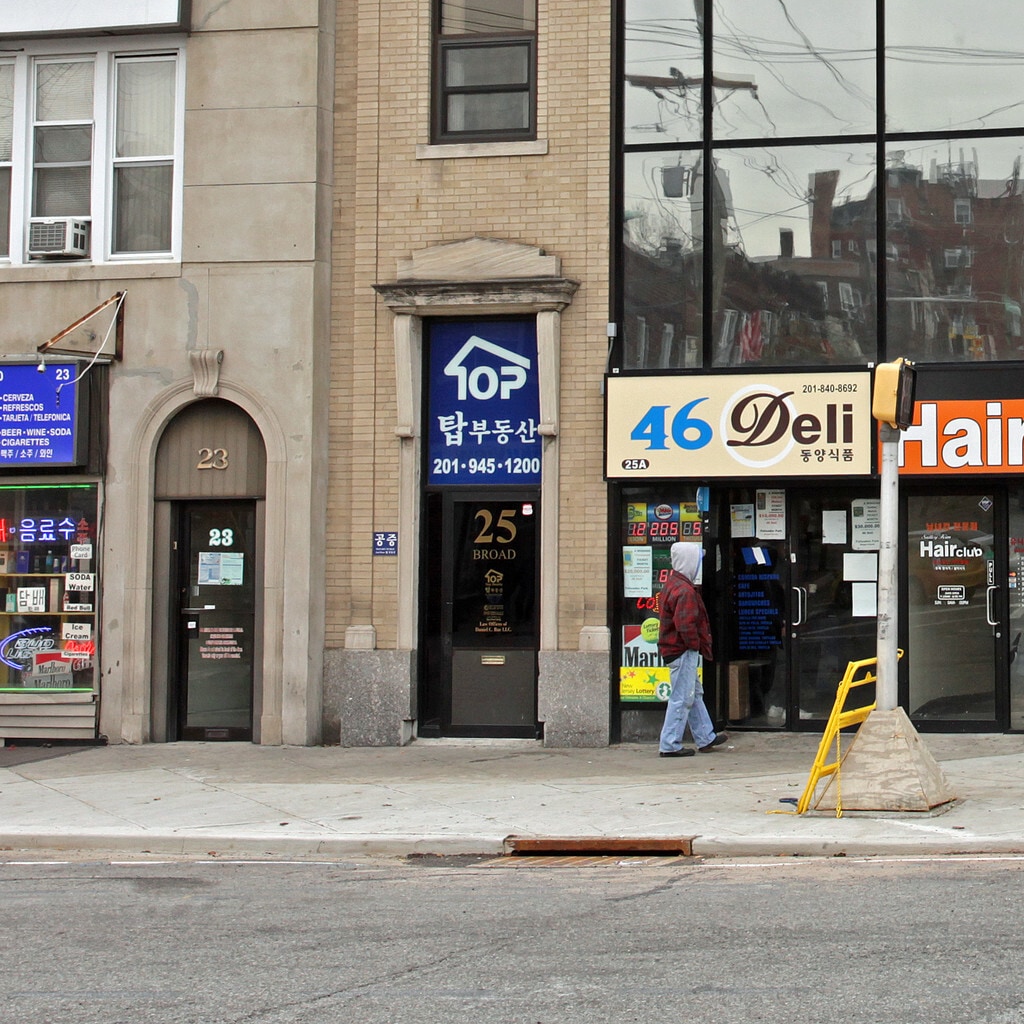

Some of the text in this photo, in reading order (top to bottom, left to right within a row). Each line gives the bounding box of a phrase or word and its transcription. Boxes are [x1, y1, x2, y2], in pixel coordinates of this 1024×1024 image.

[56, 369, 70, 381] 23
[802, 383, 858, 394] 201-840-8692
[3, 393, 34, 402] CERVEZA
[3, 403, 44, 412] REFRESCOS
[2, 413, 71, 422] TARJETA TELEFONICA
[630, 391, 854, 451] 46 Deli
[1, 427, 72, 436] BEER WINE SODA
[1, 438, 50, 446] CIGARETTES
[20, 449, 33, 458] 소주
[197, 447, 229, 470] 23
[800, 448, 854, 462] 동양식품
[624, 459, 647, 470] 25A
[19, 518, 76, 542] 음료수
[473, 508, 517, 544] 25
[650, 522, 678, 536] 205
[208, 528, 234, 547] 23
[374, 533, 397, 547] 공증
[473, 549, 516, 560] BROAD
[69, 573, 91, 581] SODA
[19, 589, 44, 607] 담배
[7, 648, 34, 659] LIG
[38, 662, 66, 674] Marlboro
